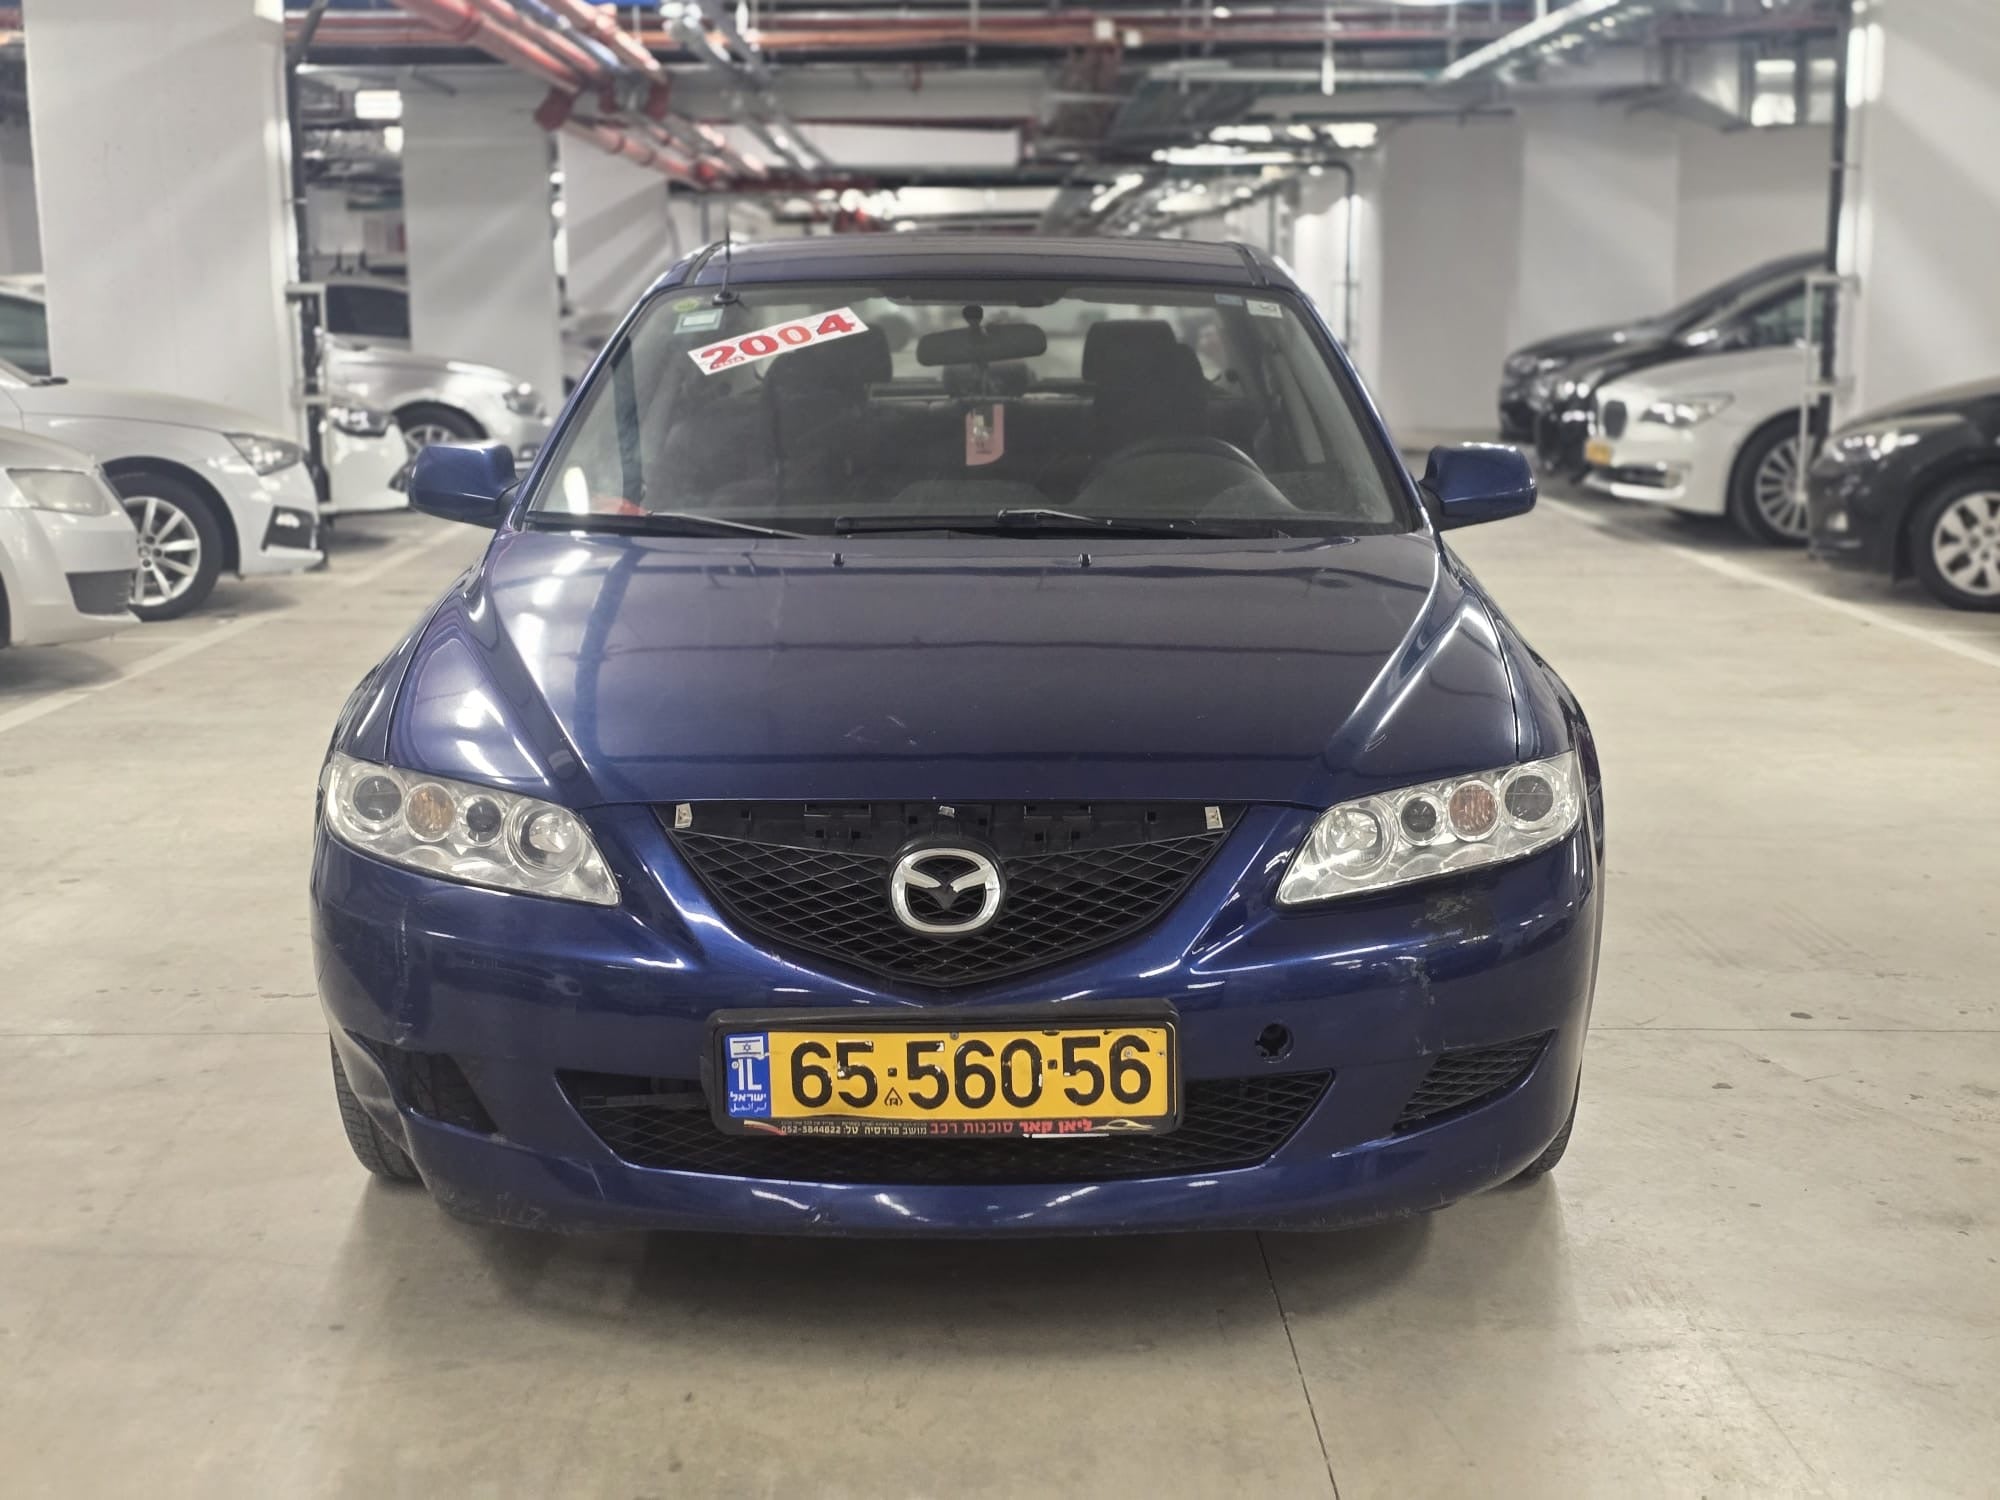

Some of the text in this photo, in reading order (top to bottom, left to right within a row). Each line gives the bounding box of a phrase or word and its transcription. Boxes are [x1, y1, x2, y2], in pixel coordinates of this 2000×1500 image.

[701, 314, 855, 370] 2004
[738, 1058, 762, 1090] IL
[730, 1091, 766, 1102] ישראל
[902, 1126, 927, 1135] מושב
[930, 1122, 957, 1134] רכב
[963, 1121, 1013, 1134] סוכנות
